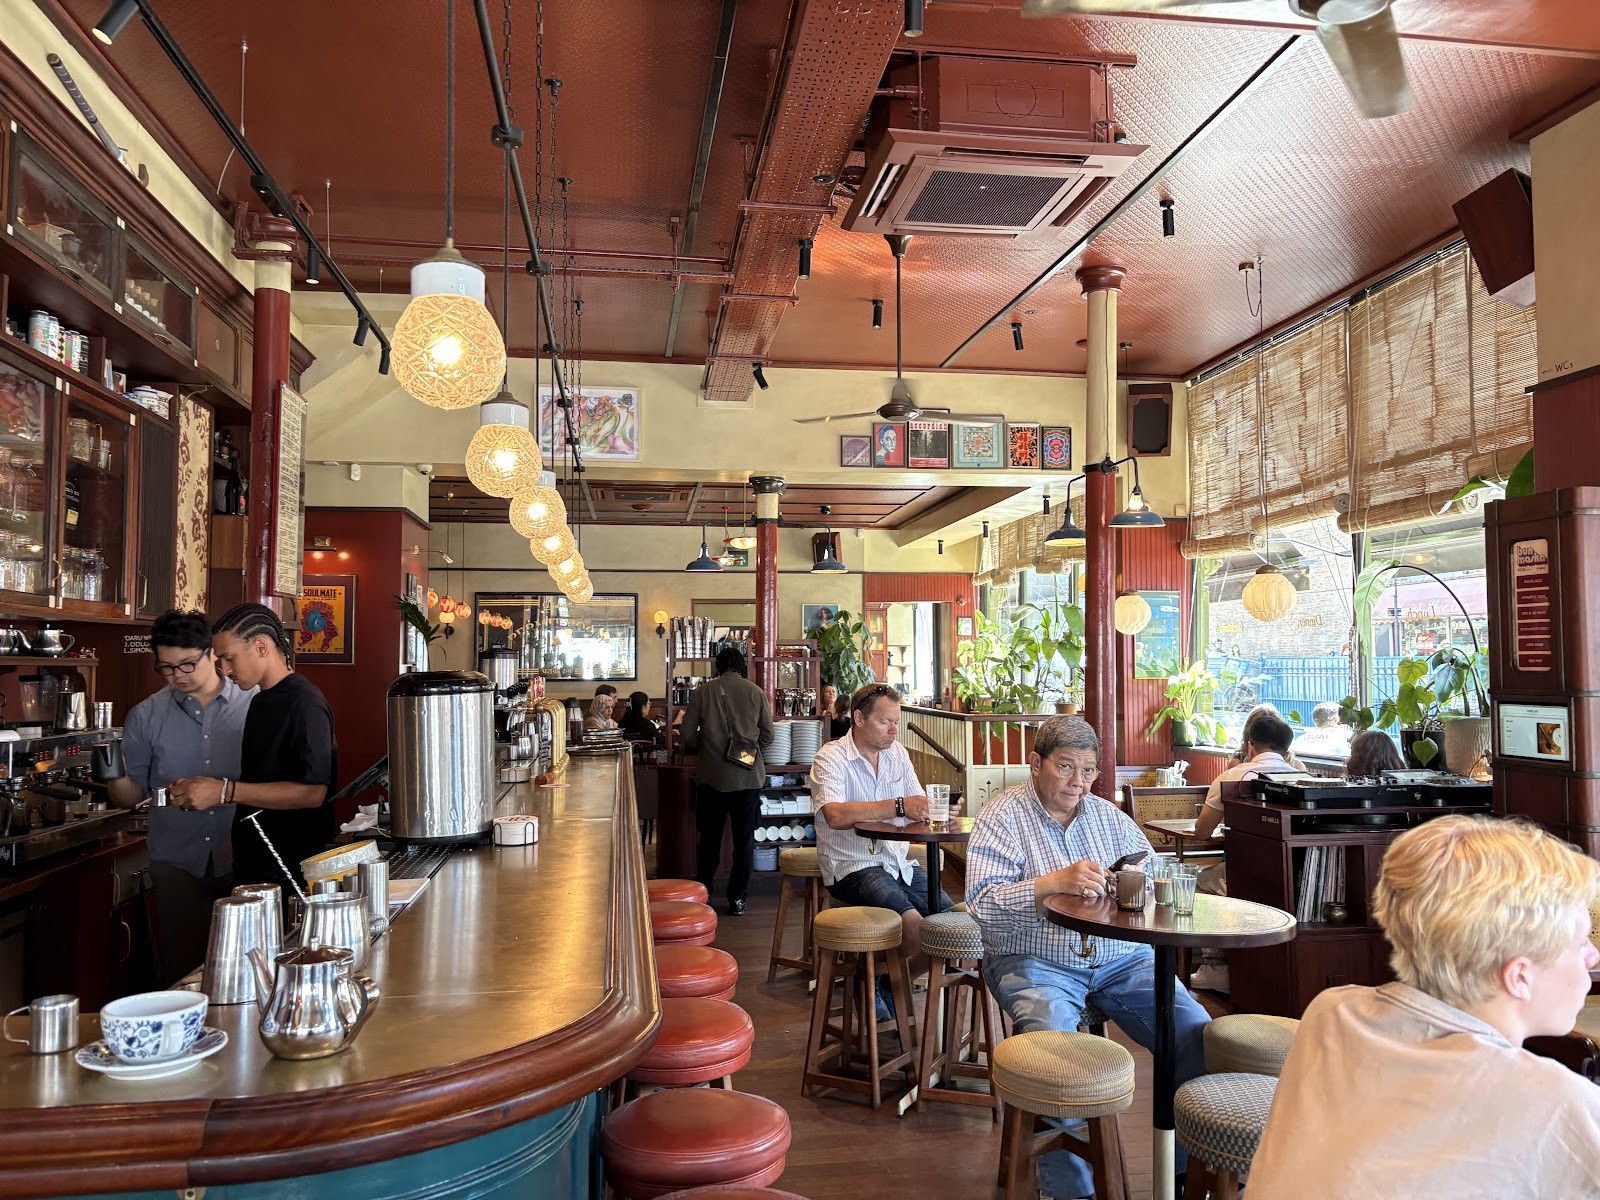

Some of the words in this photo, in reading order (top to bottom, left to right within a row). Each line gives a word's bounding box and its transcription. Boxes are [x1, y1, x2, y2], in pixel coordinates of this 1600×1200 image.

[1554, 360, 1574, 372] WCs
[910, 422, 947, 430] accordion
[1517, 546, 1534, 556] bun
[303, 589, 337, 598] SOULMATE
[1264, 783, 1282, 792] Pioneer
